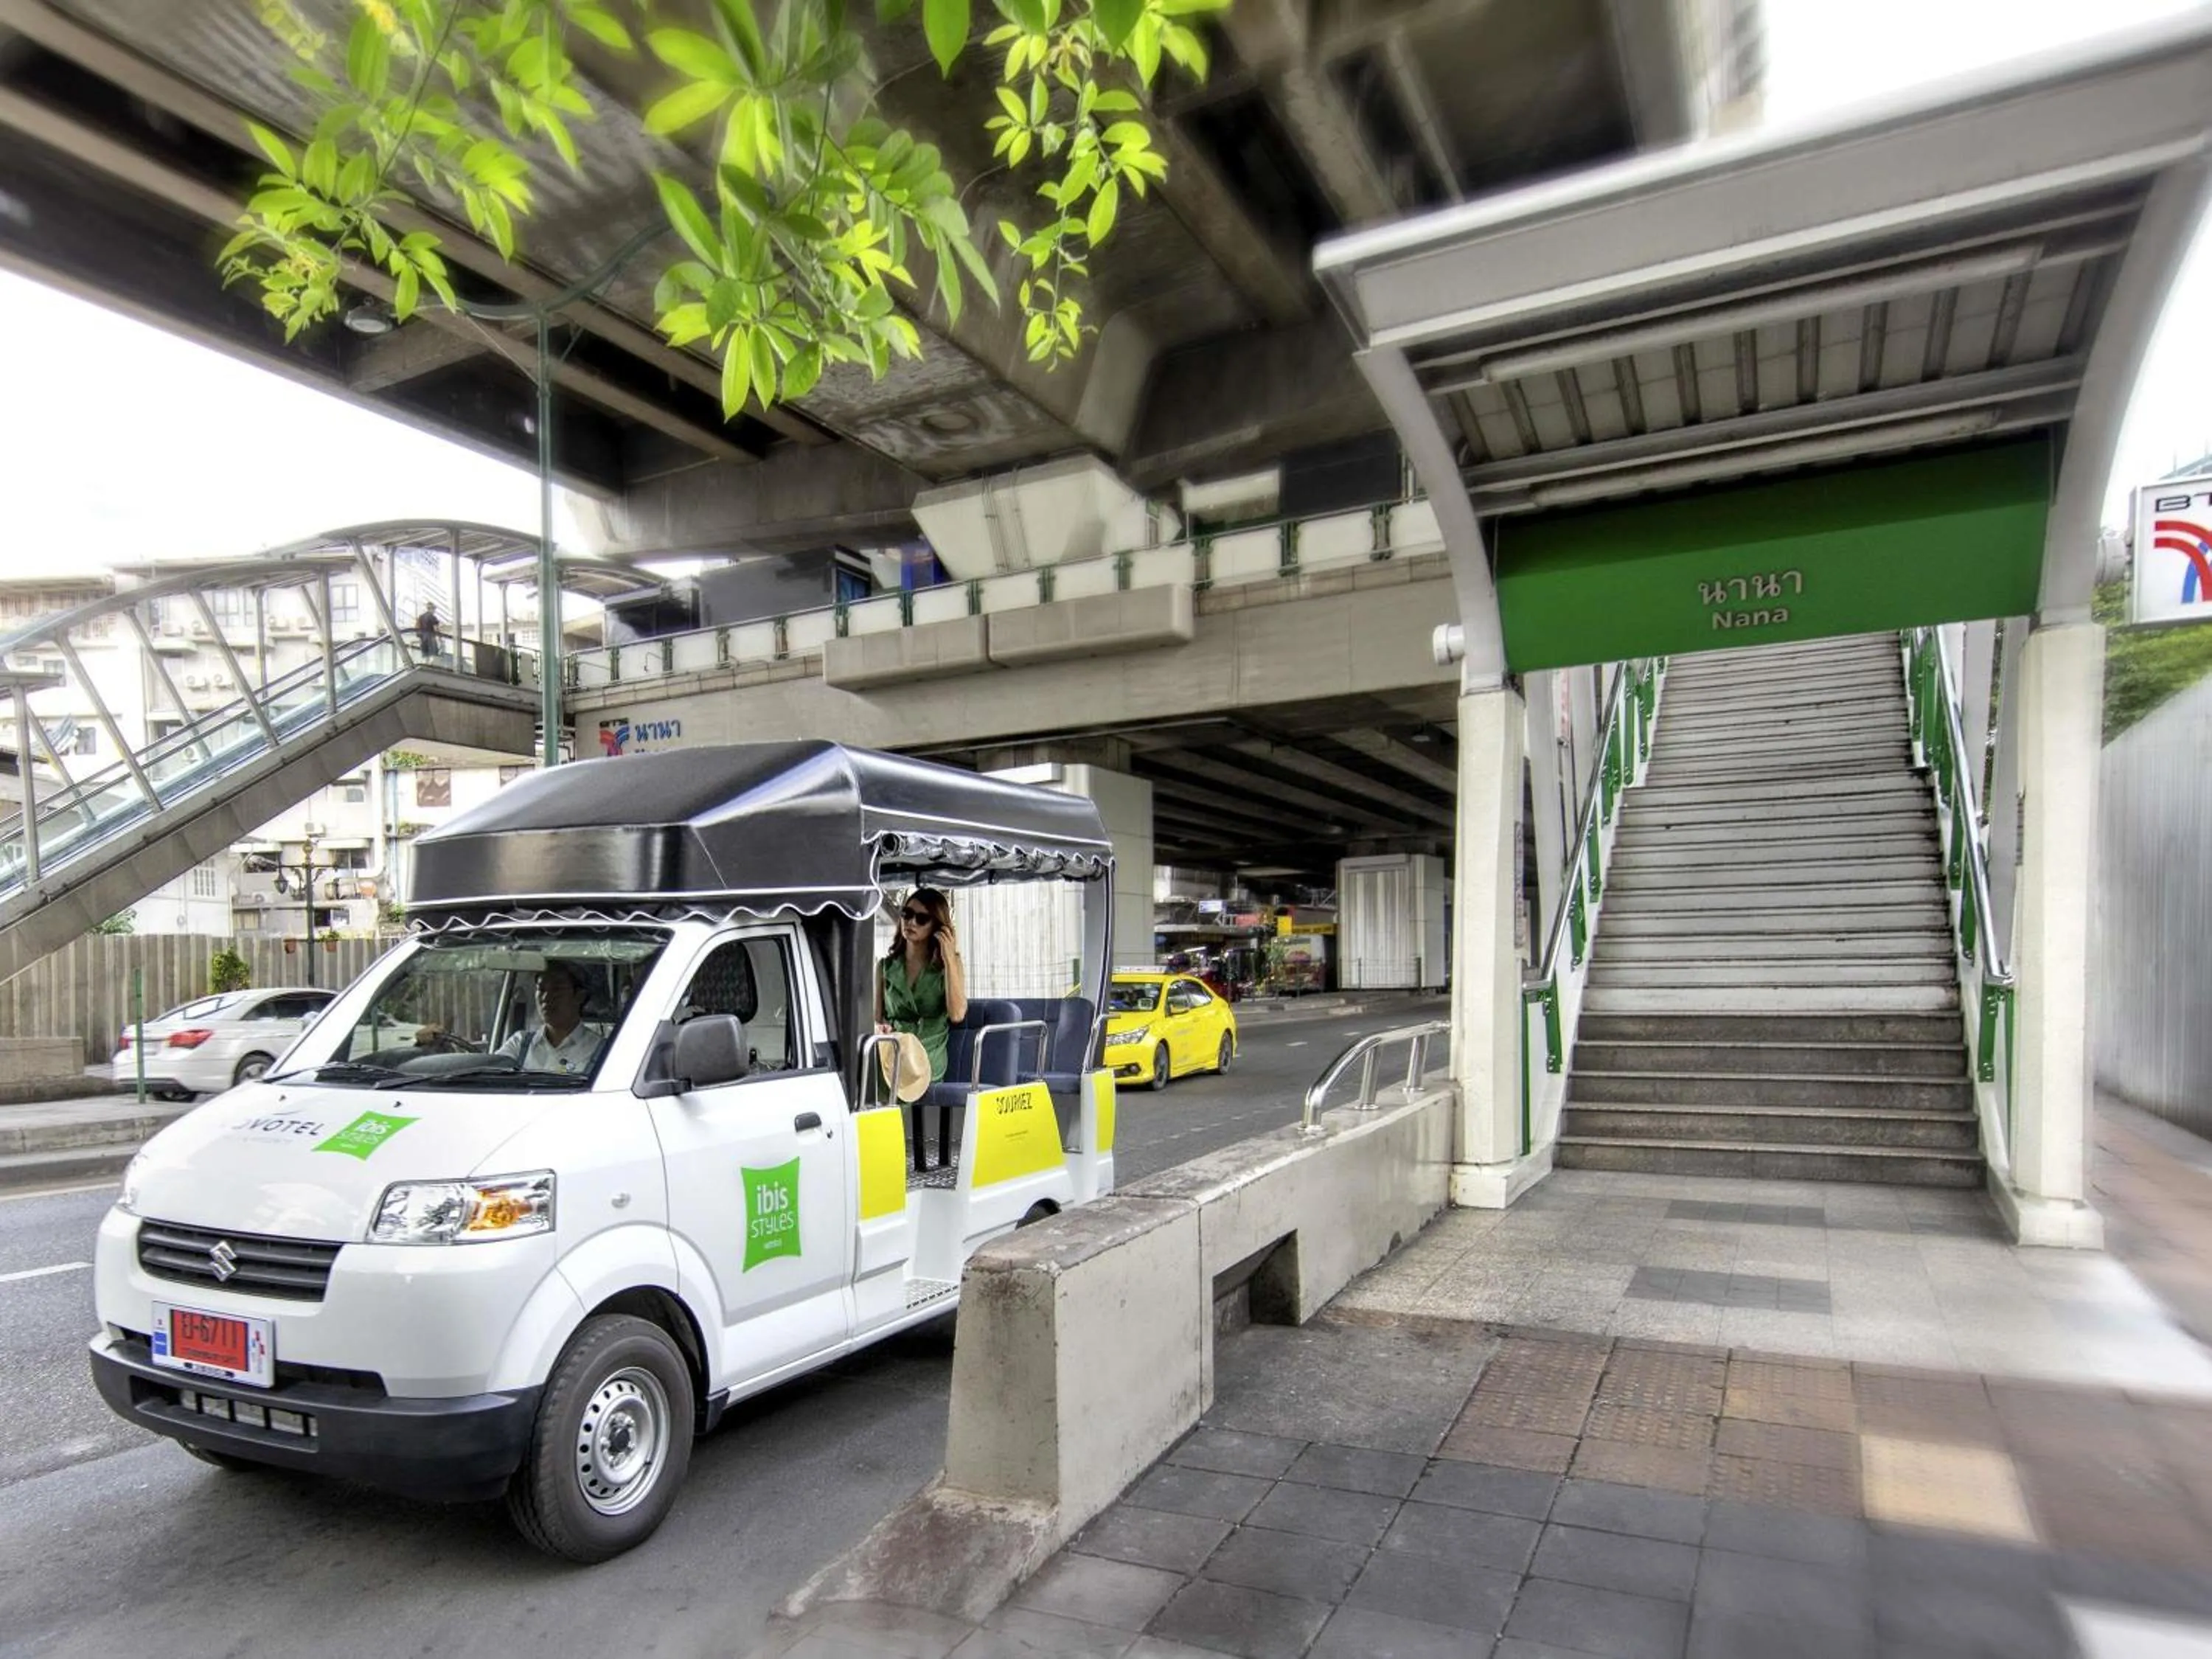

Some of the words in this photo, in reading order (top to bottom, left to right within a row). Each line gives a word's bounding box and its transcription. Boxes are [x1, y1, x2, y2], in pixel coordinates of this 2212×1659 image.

[1698, 571, 1802, 605] นานา
[1712, 608, 1788, 630] Nana
[635, 720, 681, 742] นานา
[230, 1119, 324, 1136] VOTEL
[757, 1181, 788, 1215] ibis
